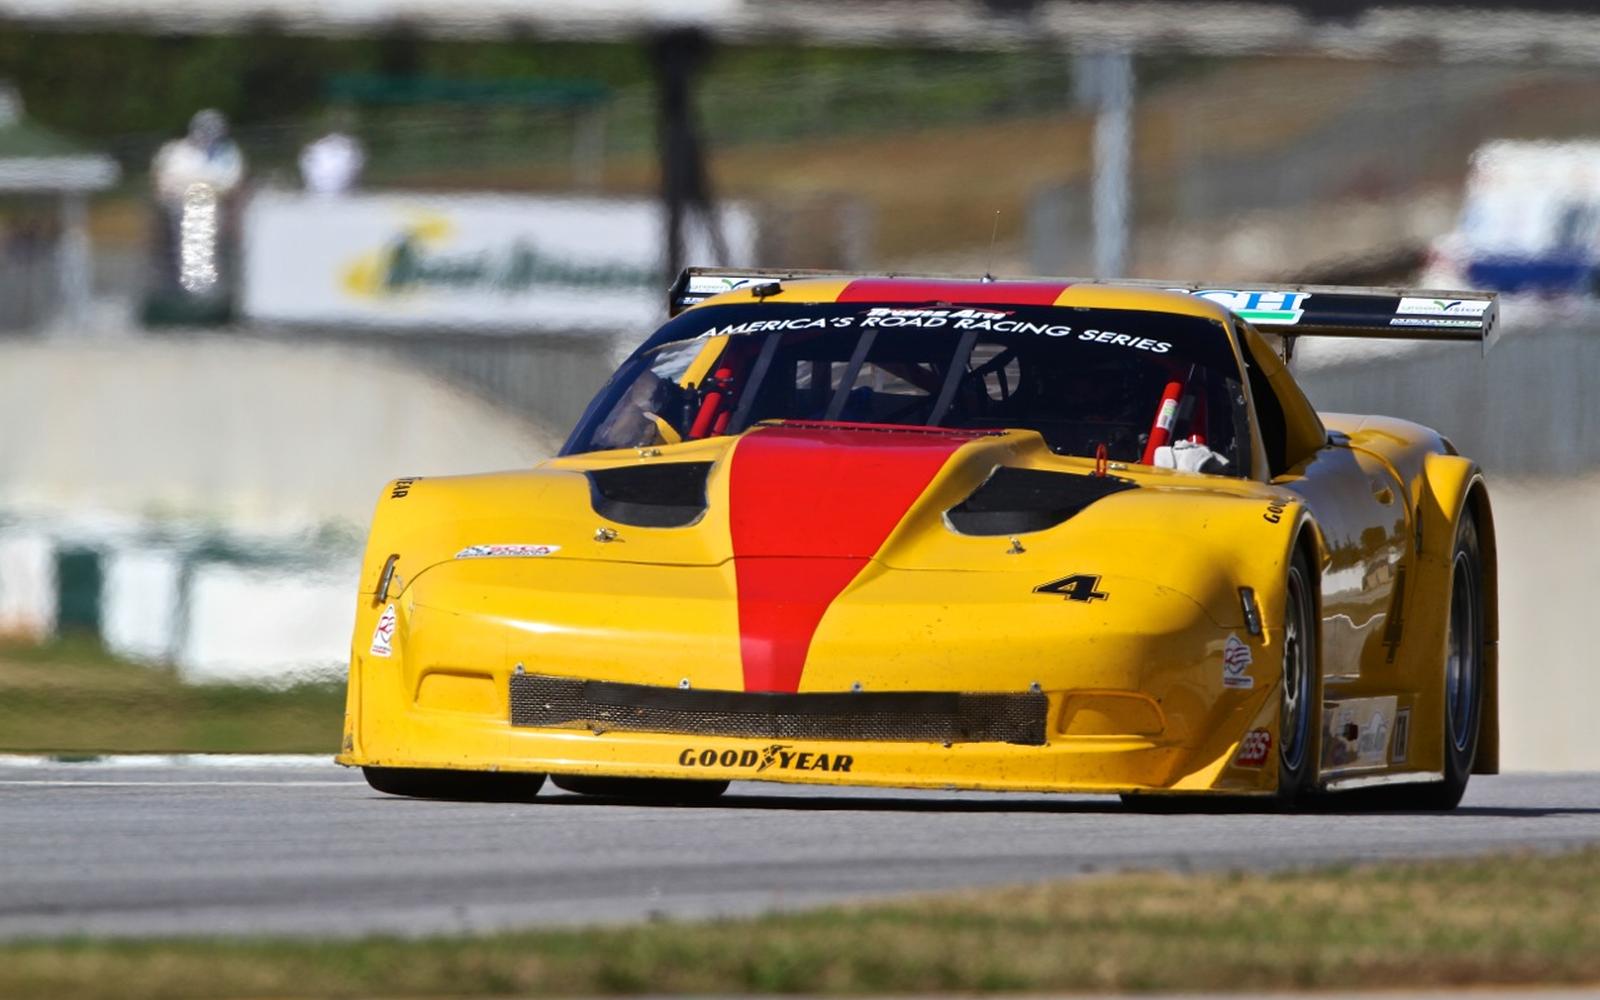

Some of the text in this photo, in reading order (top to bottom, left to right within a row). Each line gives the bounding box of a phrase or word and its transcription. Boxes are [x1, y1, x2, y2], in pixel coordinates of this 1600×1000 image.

[696, 317, 1173, 353] AMERICA'S ROAD RACING SERIES
[1031, 573, 1110, 604] 4
[679, 748, 854, 773] GOODYEAR
